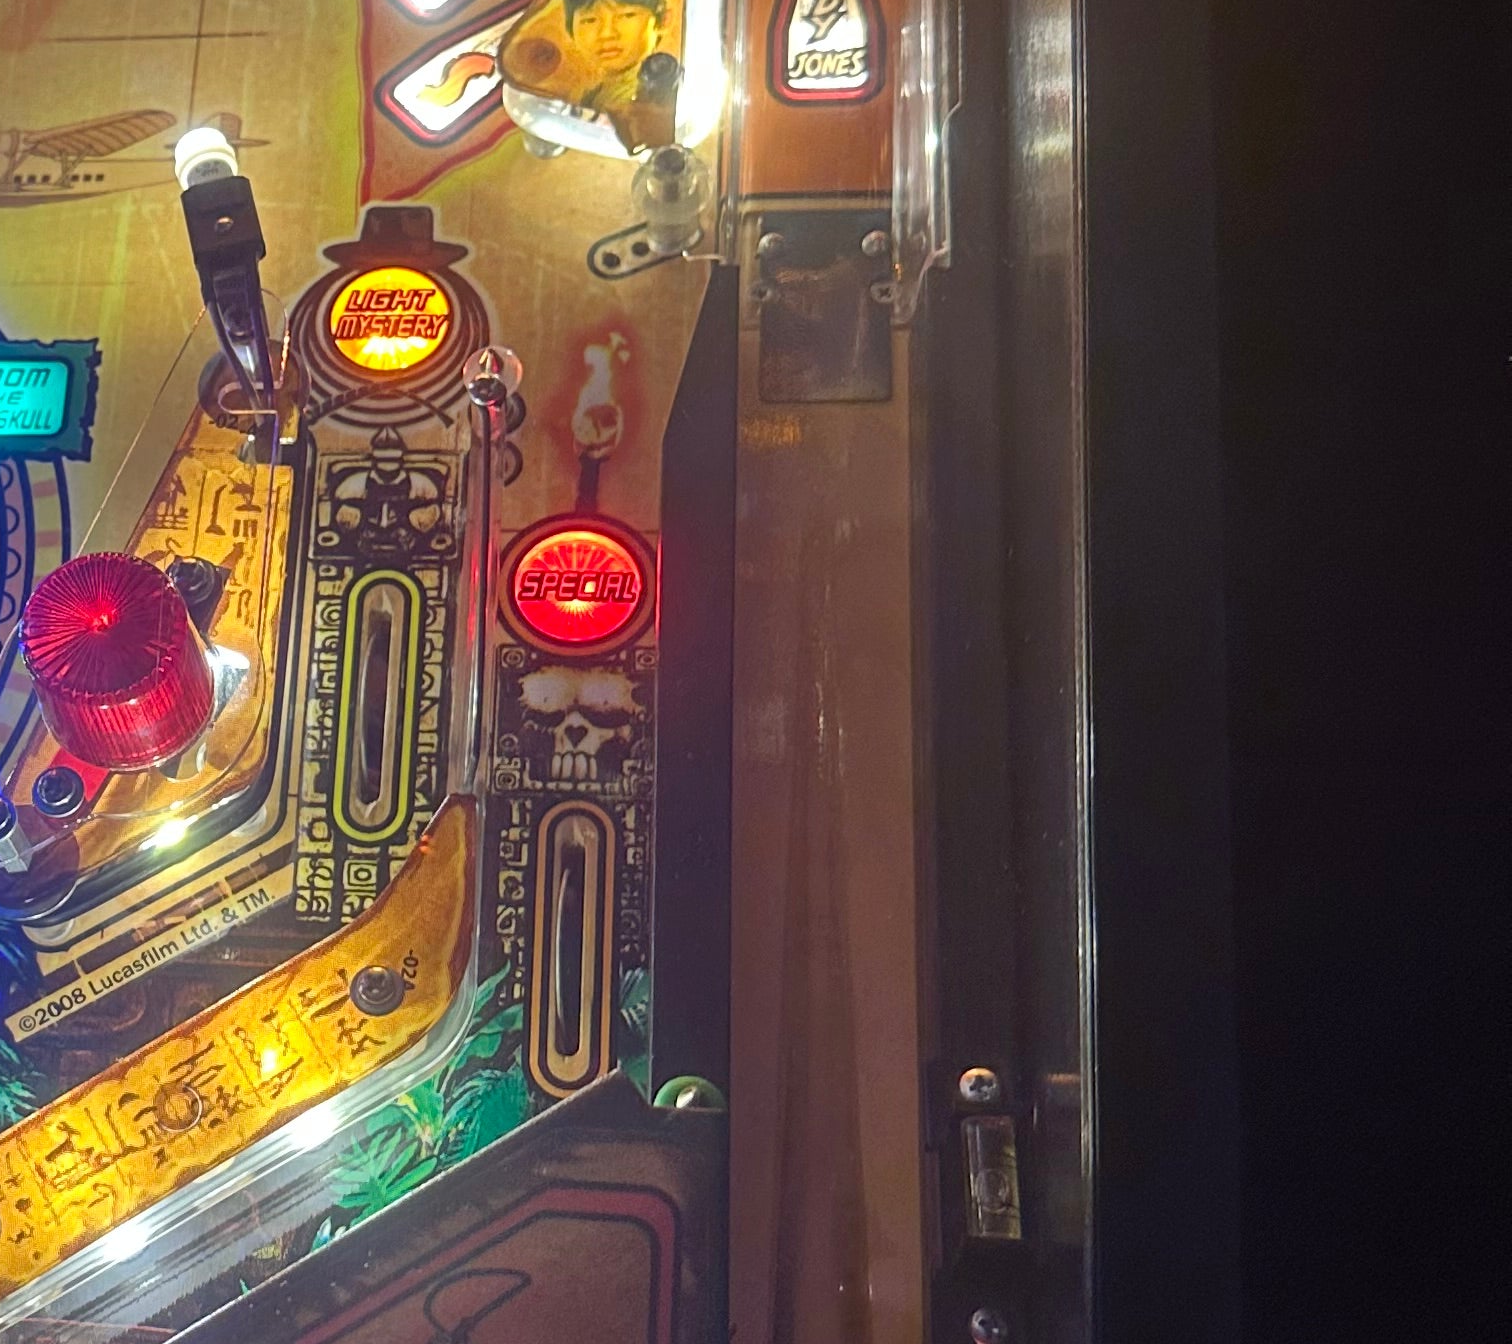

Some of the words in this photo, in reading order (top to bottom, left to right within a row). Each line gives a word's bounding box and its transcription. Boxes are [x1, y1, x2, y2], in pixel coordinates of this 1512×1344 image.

[789, 47, 867, 78] JONES
[346, 289, 435, 311] LIGHT
[335, 315, 446, 339] MYSTERY
[518, 570, 636, 601] SPECIAL
[19, 988, 86, 1032] ©2008
[89, 940, 179, 996] Lucasfilm
[181, 918, 219, 946] Ltd.
[222, 907, 239, 924] &
[237, 888, 276, 914] TM.
